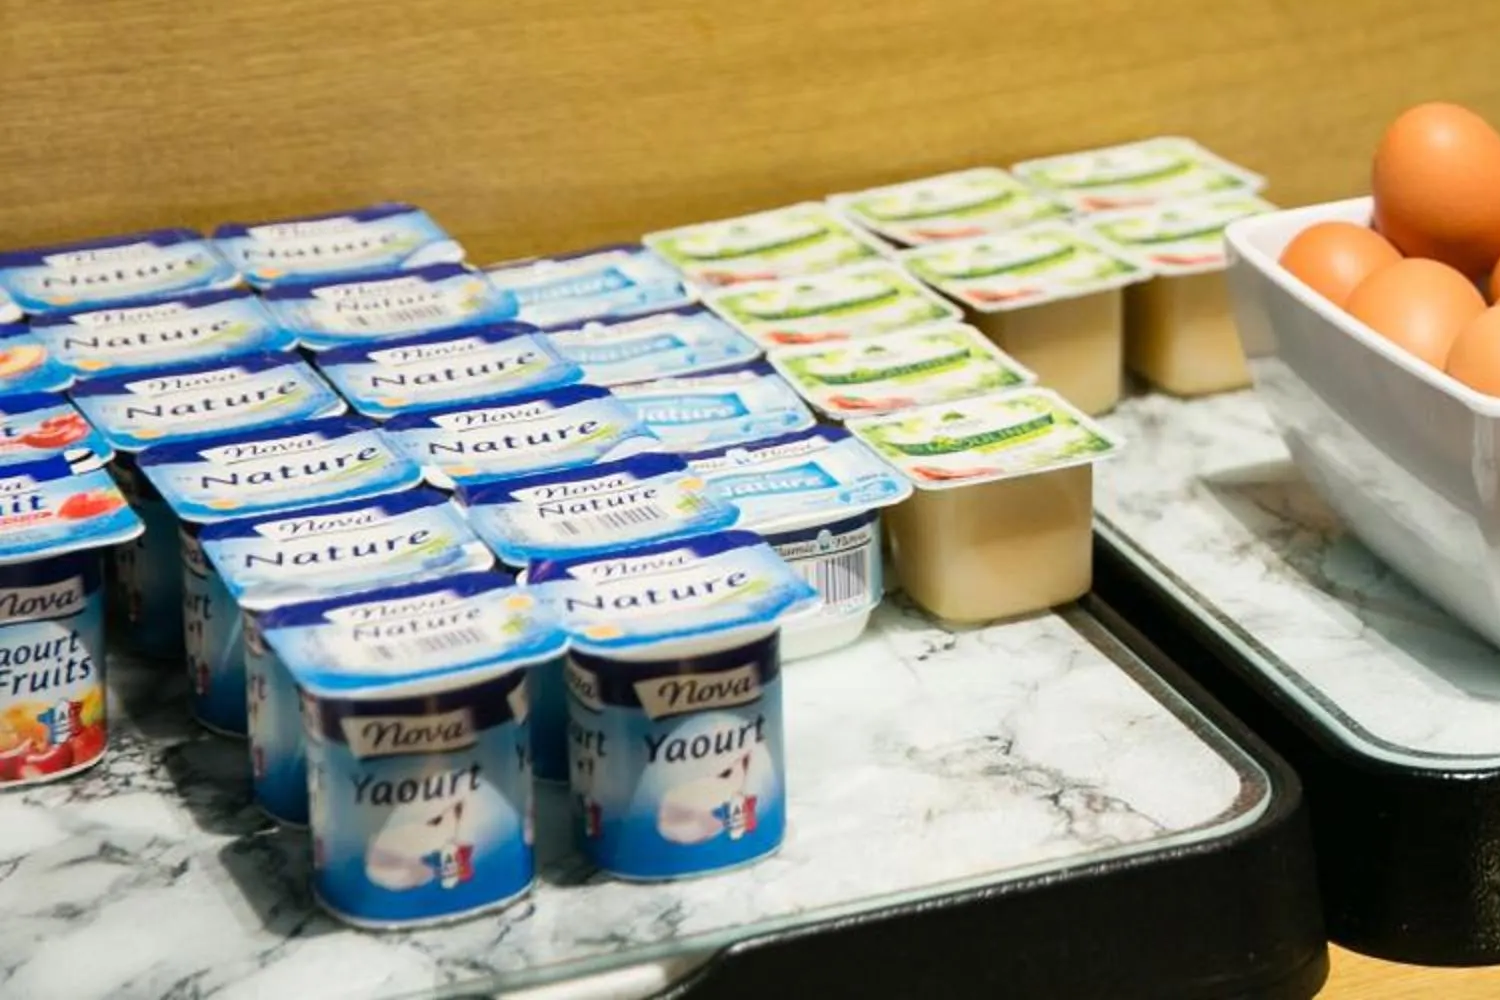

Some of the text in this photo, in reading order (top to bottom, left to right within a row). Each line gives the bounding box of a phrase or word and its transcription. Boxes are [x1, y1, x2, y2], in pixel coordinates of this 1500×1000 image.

[242, 231, 399, 261] Nature
[42, 257, 201, 289] Nature
[334, 290, 441, 315] Nature
[64, 318, 230, 351] Nature
[391, 340, 479, 361] Nova
[148, 370, 238, 392] Nova
[371, 349, 537, 388] Nature
[127, 380, 299, 419] Nature
[455, 402, 543, 427] Nova
[224, 435, 316, 460] Nova
[428, 417, 599, 455] Nature
[201, 445, 378, 489] Nature
[533, 476, 627, 500] Nova
[538, 486, 657, 519] Nature
[278, 509, 377, 535] Nova
[245, 527, 432, 568] Nature
[590, 552, 689, 577] Nova
[350, 594, 448, 619] Nova
[565, 570, 749, 612] Nature
[351, 606, 482, 641] Nature
[0, 628, 79, 668] aourt
[658, 675, 755, 707] Nova
[362, 720, 470, 750] Nova
[644, 715, 767, 764] Yaourt
[350, 762, 482, 807] Yaourt
